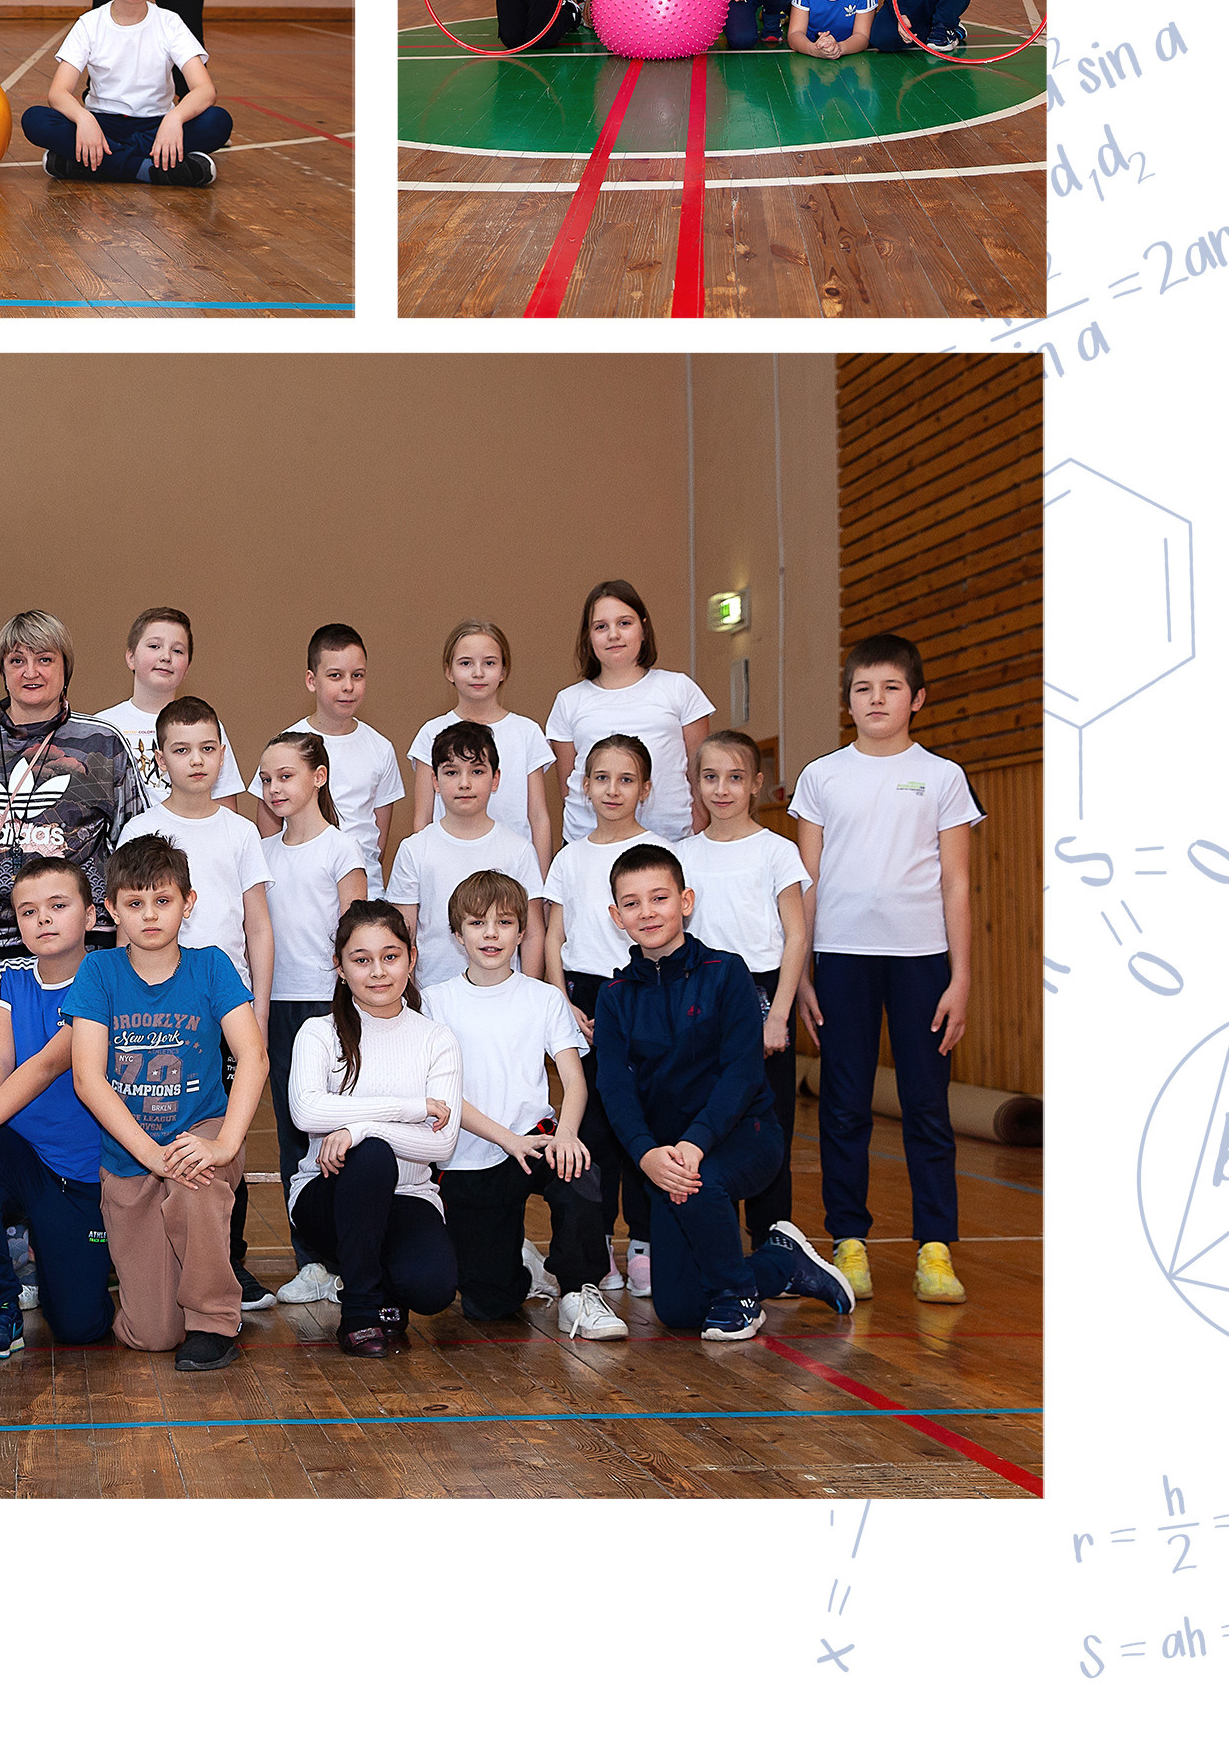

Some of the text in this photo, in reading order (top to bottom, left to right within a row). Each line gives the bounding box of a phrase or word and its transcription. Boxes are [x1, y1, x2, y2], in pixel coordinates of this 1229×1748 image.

[114, 1030, 184, 1047] New York
[112, 1079, 181, 1097] CHAMPIONS
[152, 1104, 172, 1112] BRKLN
[144, 1114, 176, 1122] LEAGUE
